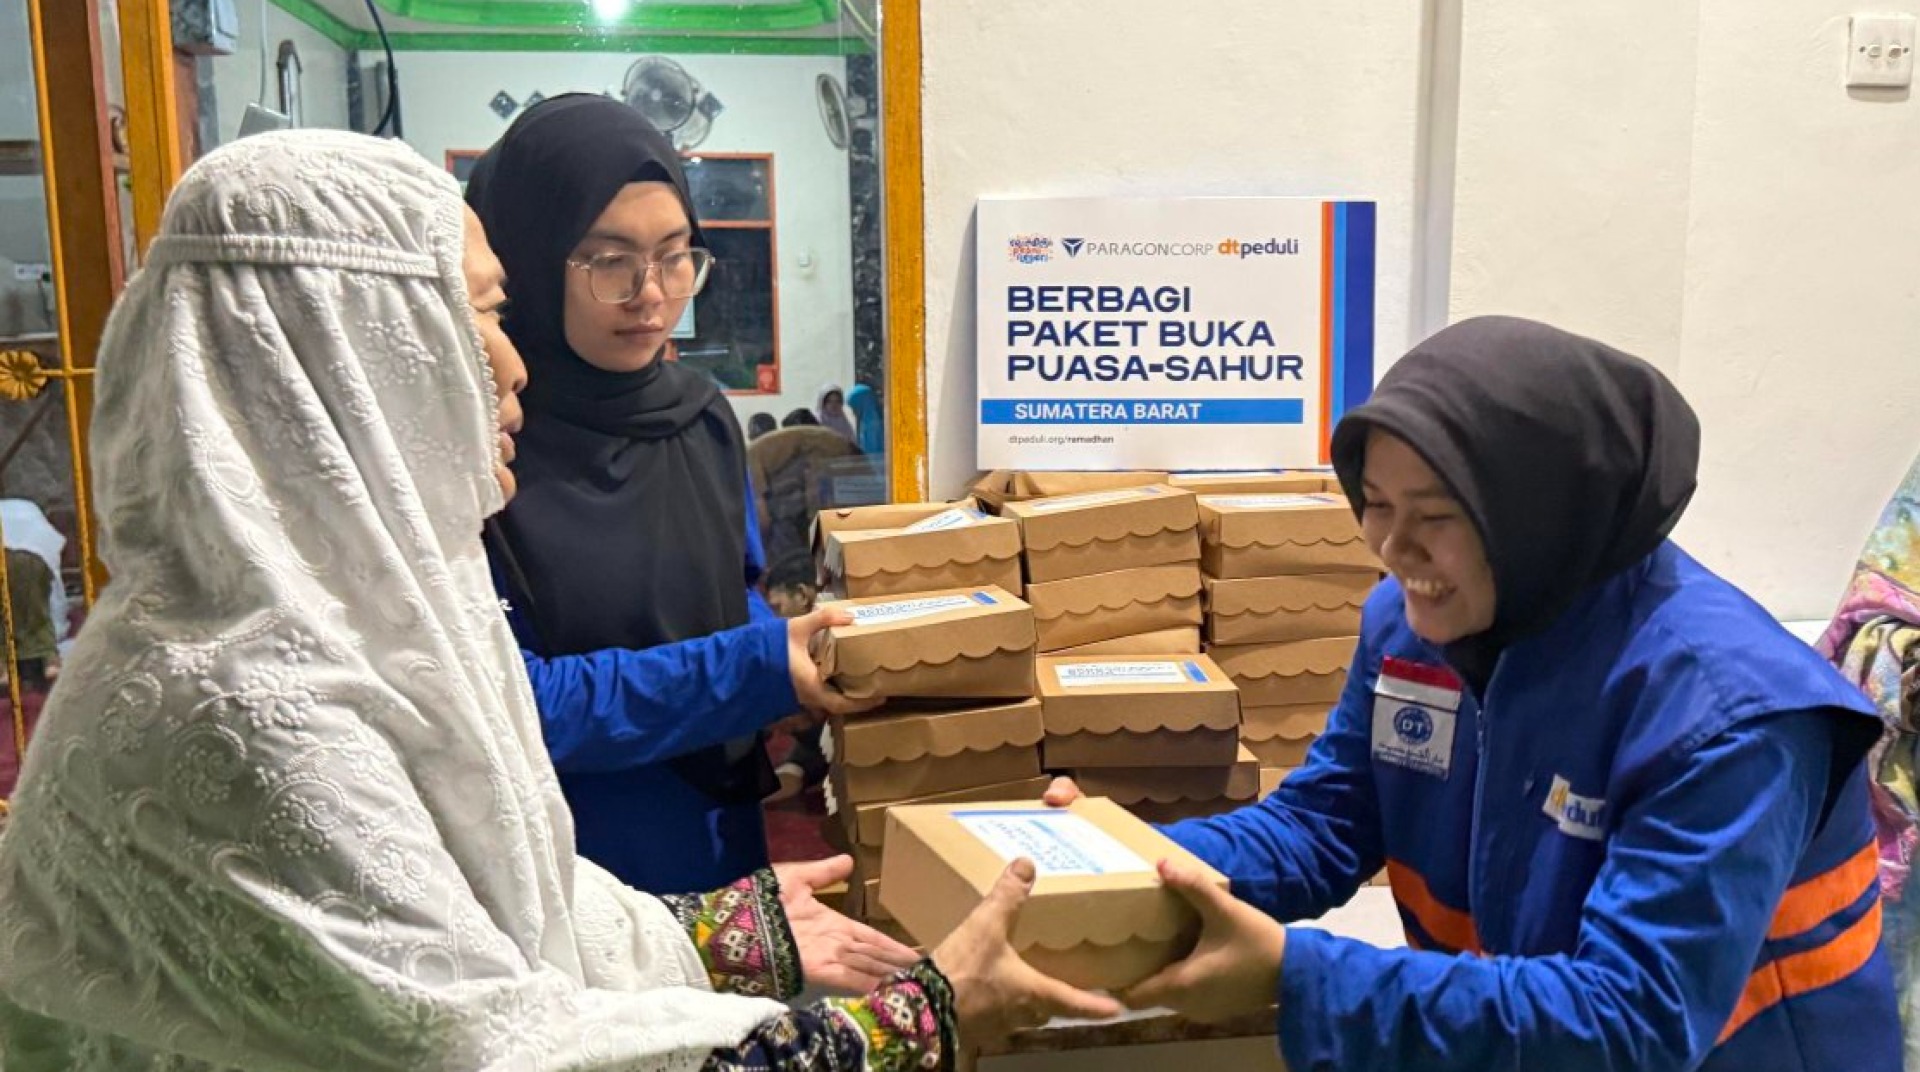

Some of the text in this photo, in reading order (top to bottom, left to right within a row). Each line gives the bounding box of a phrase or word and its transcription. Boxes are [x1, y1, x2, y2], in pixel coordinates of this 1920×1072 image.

[1086, 238, 1299, 258] PARAGONCORP dtpeduli
[1007, 286, 1190, 313] BERBAGI
[1007, 321, 1275, 347] PAKET BUKA
[1007, 355, 1303, 381] PUASA-SAHUR
[1014, 403, 1203, 420] SUMATERA BARAT
[1008, 435, 1114, 445] dtpeduli.org/ramadhan
